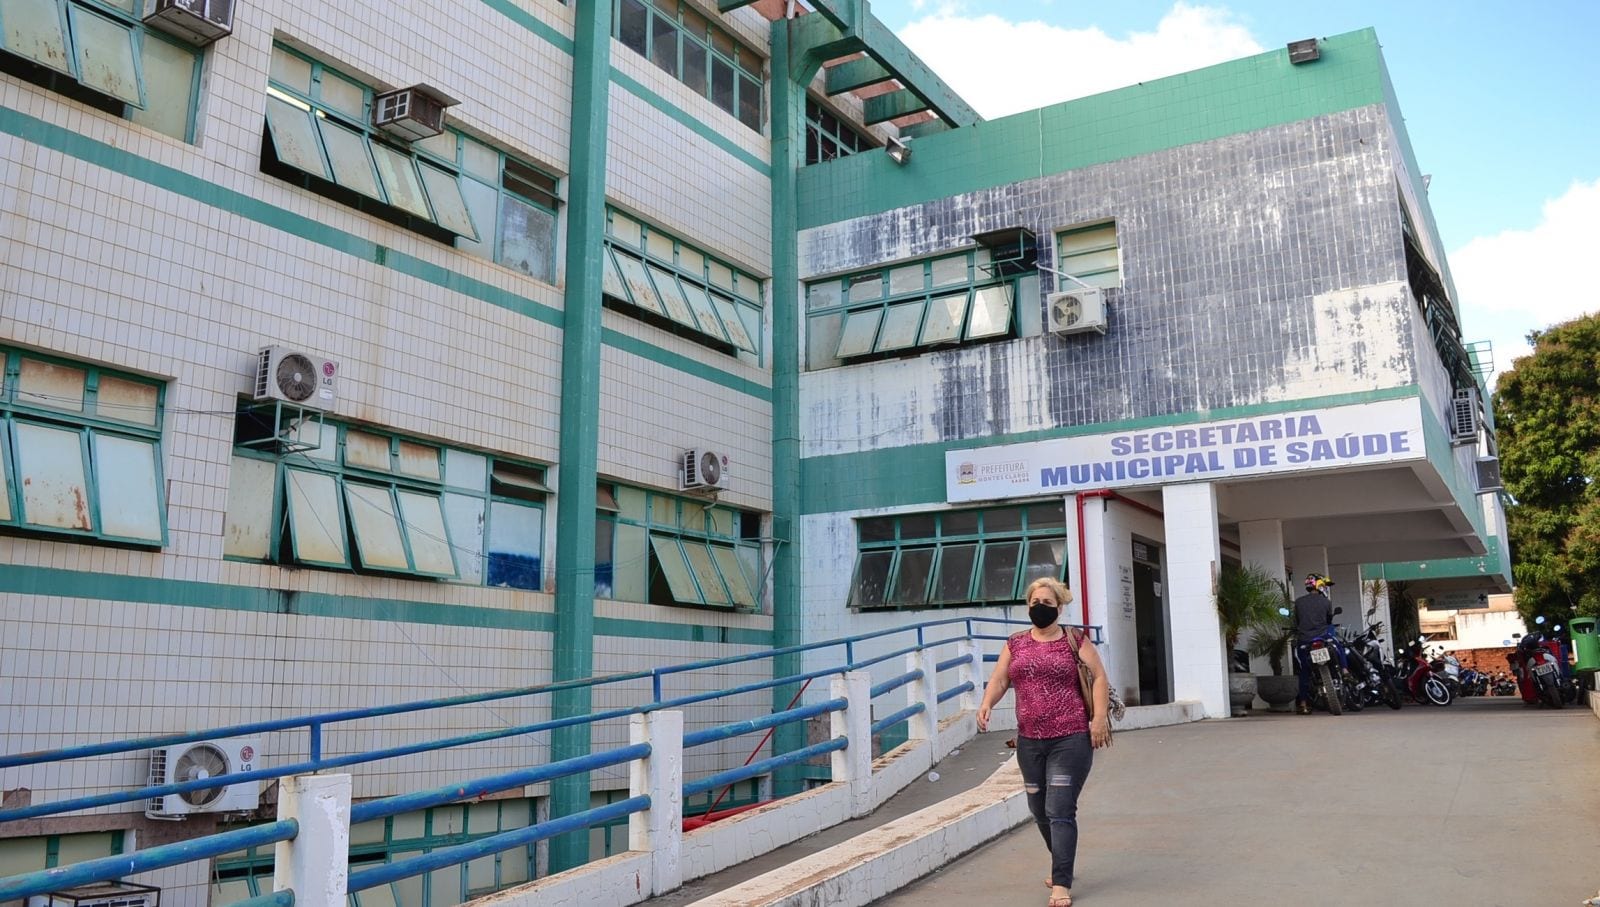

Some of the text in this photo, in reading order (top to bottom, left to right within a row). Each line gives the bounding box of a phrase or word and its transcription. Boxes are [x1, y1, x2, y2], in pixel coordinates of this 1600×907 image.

[322, 378, 332, 386] LG
[1111, 414, 1322, 456] SECRETARIA
[1040, 430, 1411, 488] MUNICIPAL DE SAÚDE
[981, 462, 1024, 475] PREFEITURA
[240, 764, 252, 772] LG
